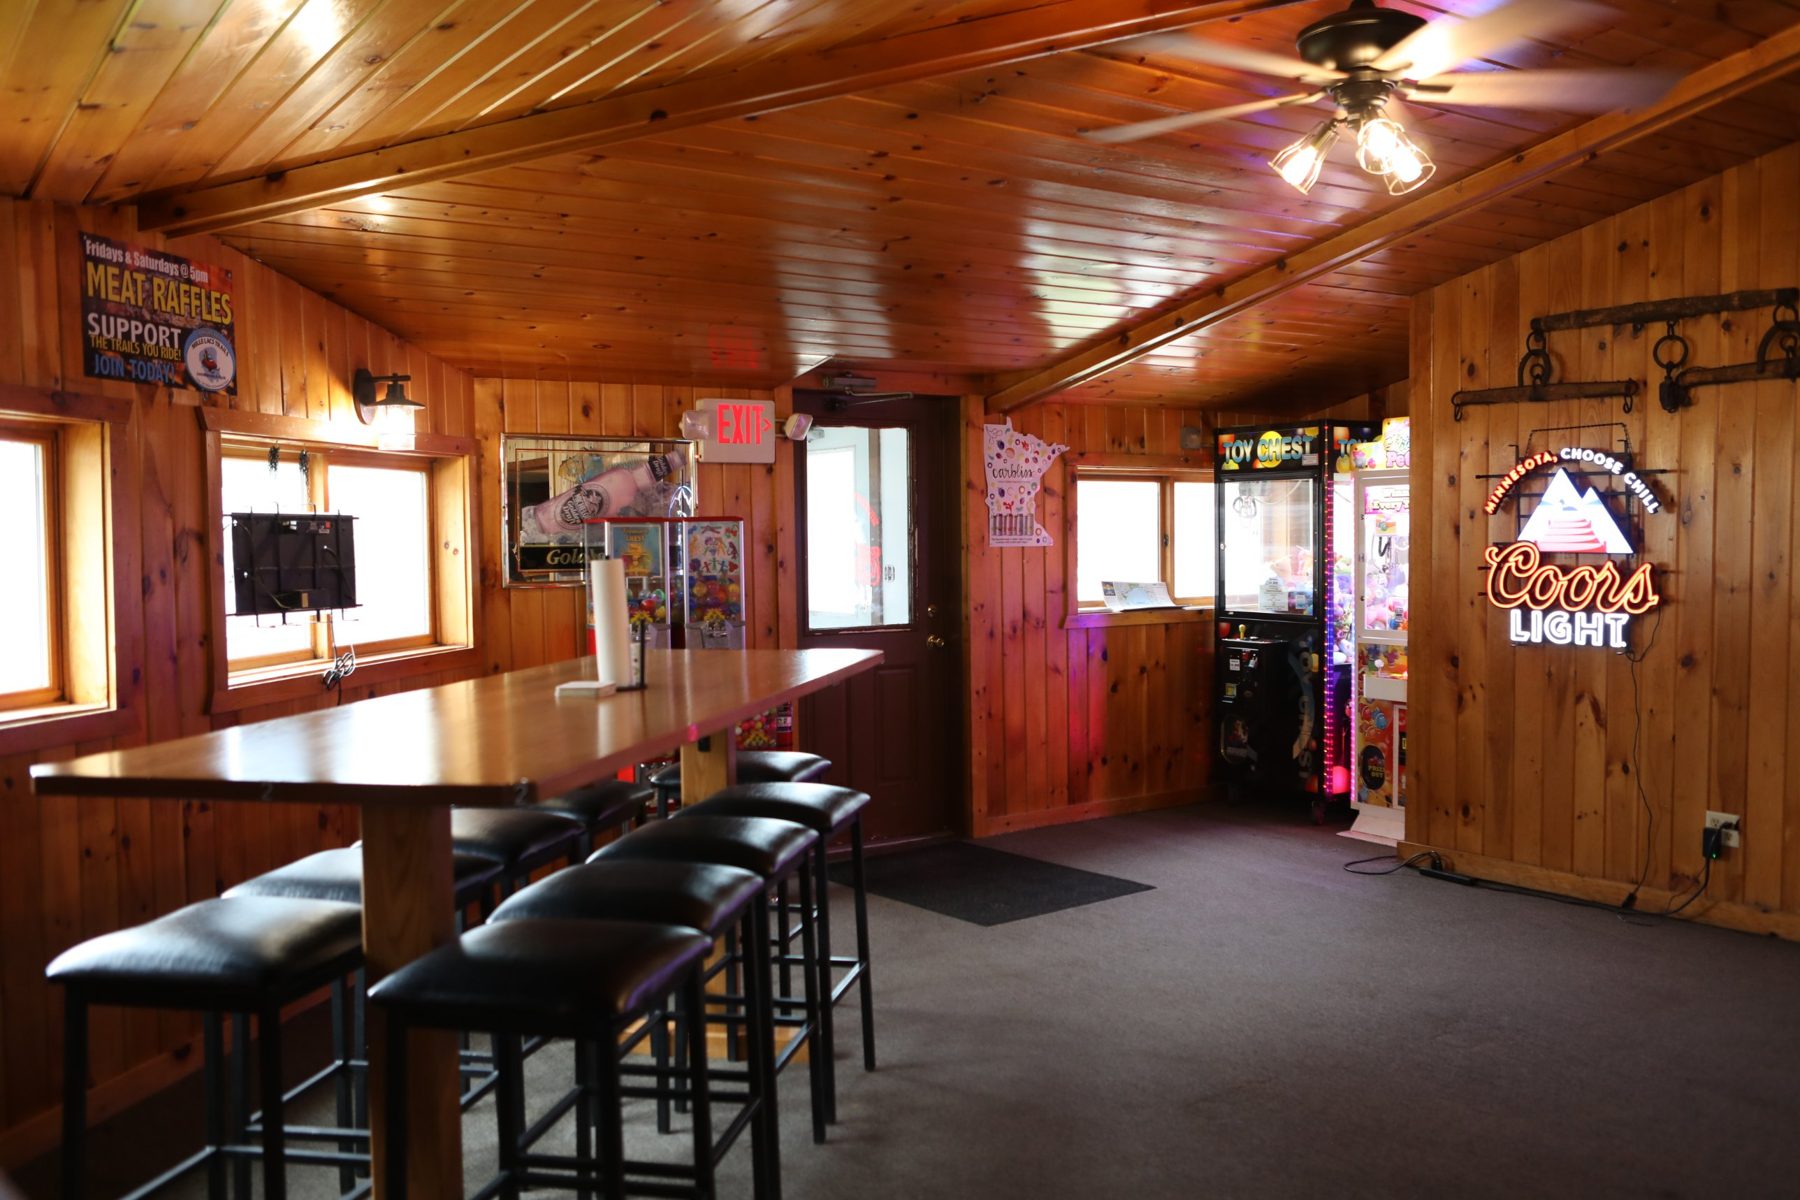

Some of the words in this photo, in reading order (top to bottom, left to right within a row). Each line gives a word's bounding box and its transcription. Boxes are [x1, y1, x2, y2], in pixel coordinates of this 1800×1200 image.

[85, 239, 124, 263] Fridays
[125, 251, 132, 263] &
[134, 251, 179, 277] Saturdays
[180, 263, 189, 279] @
[190, 266, 209, 283] 5pm
[86, 261, 146, 307] MEAT
[152, 276, 232, 324] RAFFLES
[87, 312, 182, 349] SUPPORT
[90, 335, 108, 349] THE
[111, 337, 140, 355] TRAILS
[142, 343, 159, 357] YOU
[161, 348, 182, 361] RIDE!
[94, 354, 124, 377] JOIN
[129, 359, 175, 384] TODAY!
[717, 404, 764, 444] EXIT
[1223, 438, 1254, 463] TOY
[1256, 435, 1316, 462] CHEST
[1484, 451, 1558, 514] MINNESOTA,
[1560, 447, 1623, 475] CHOOSE
[1624, 472, 1661, 514] CHILL
[1484, 541, 1660, 614] Coors
[1510, 608, 1630, 648] LIGHT
